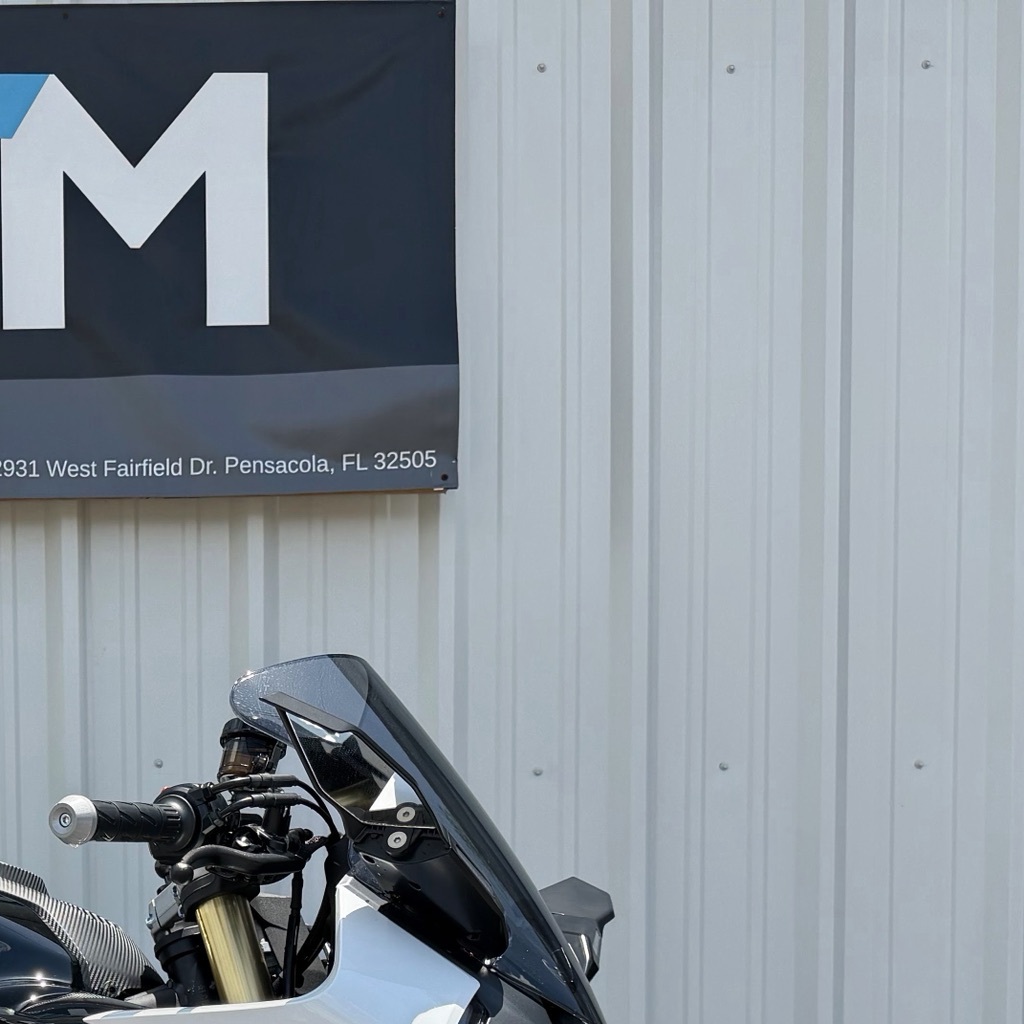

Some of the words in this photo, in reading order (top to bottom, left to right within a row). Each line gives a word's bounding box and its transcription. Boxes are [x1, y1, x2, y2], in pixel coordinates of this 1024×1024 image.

[45, 459, 98, 478] West
[104, 457, 183, 478] Fairfield
[190, 457, 217, 476] Dr.
[225, 454, 335, 475] Pensacola,
[342, 453, 369, 472] FL
[373, 449, 437, 471] 32505
